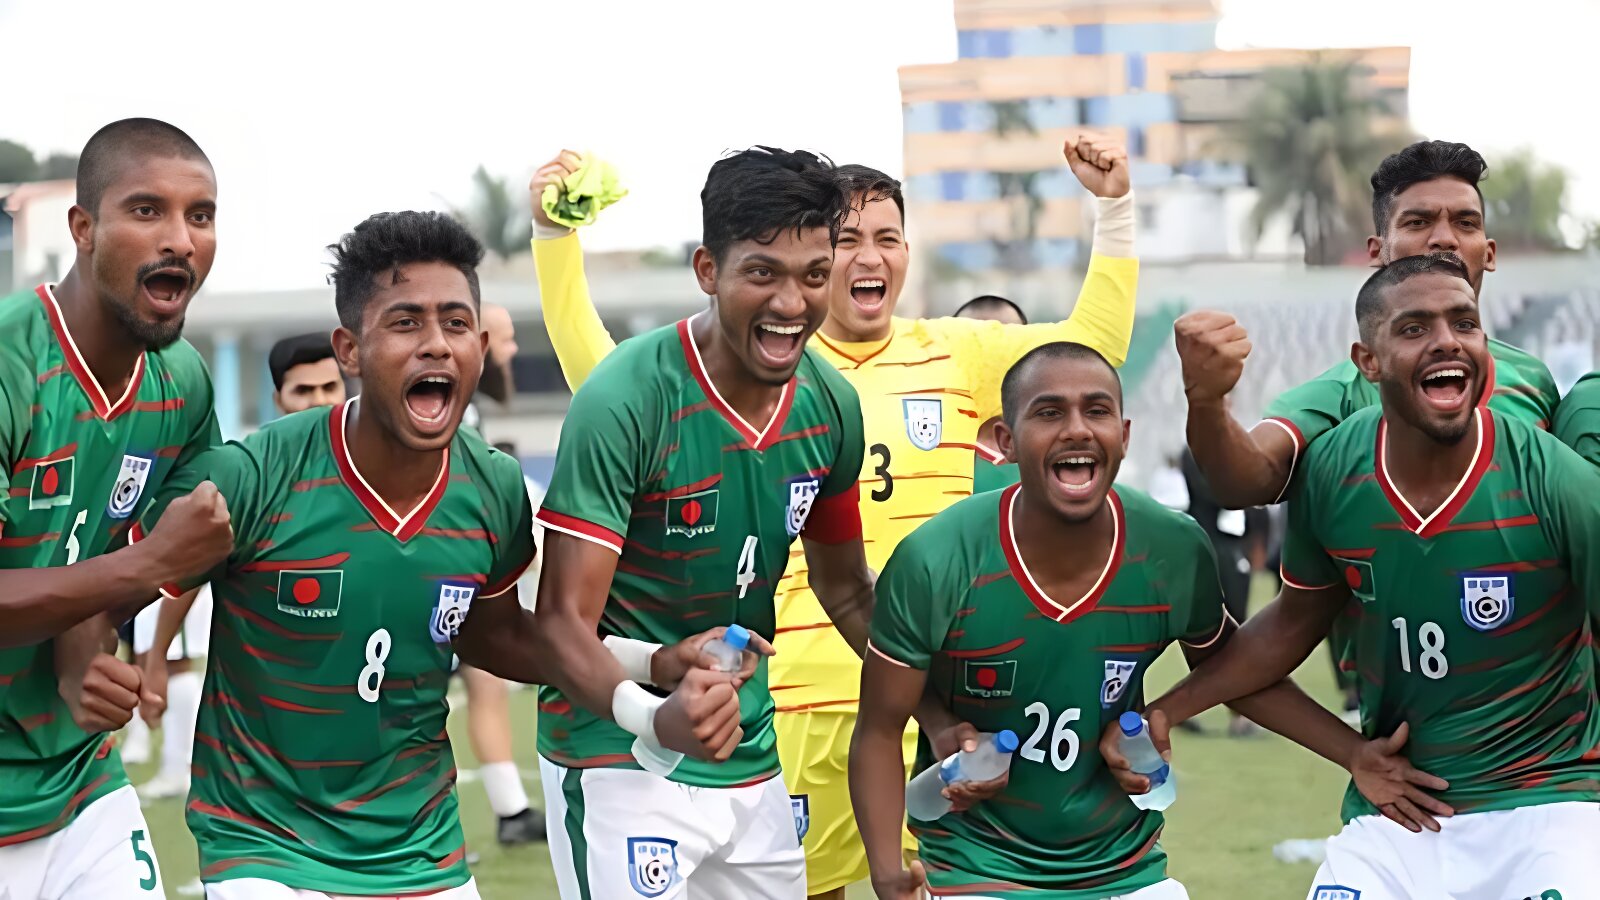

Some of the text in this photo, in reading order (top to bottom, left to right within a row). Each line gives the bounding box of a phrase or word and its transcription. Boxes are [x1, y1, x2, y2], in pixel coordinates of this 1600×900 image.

[870, 443, 894, 502] 3
[736, 535, 757, 599] 4
[357, 628, 392, 703] 8
[1392, 616, 1449, 680] 18
[1020, 701, 1081, 772] 26
[131, 829, 157, 891] 5
